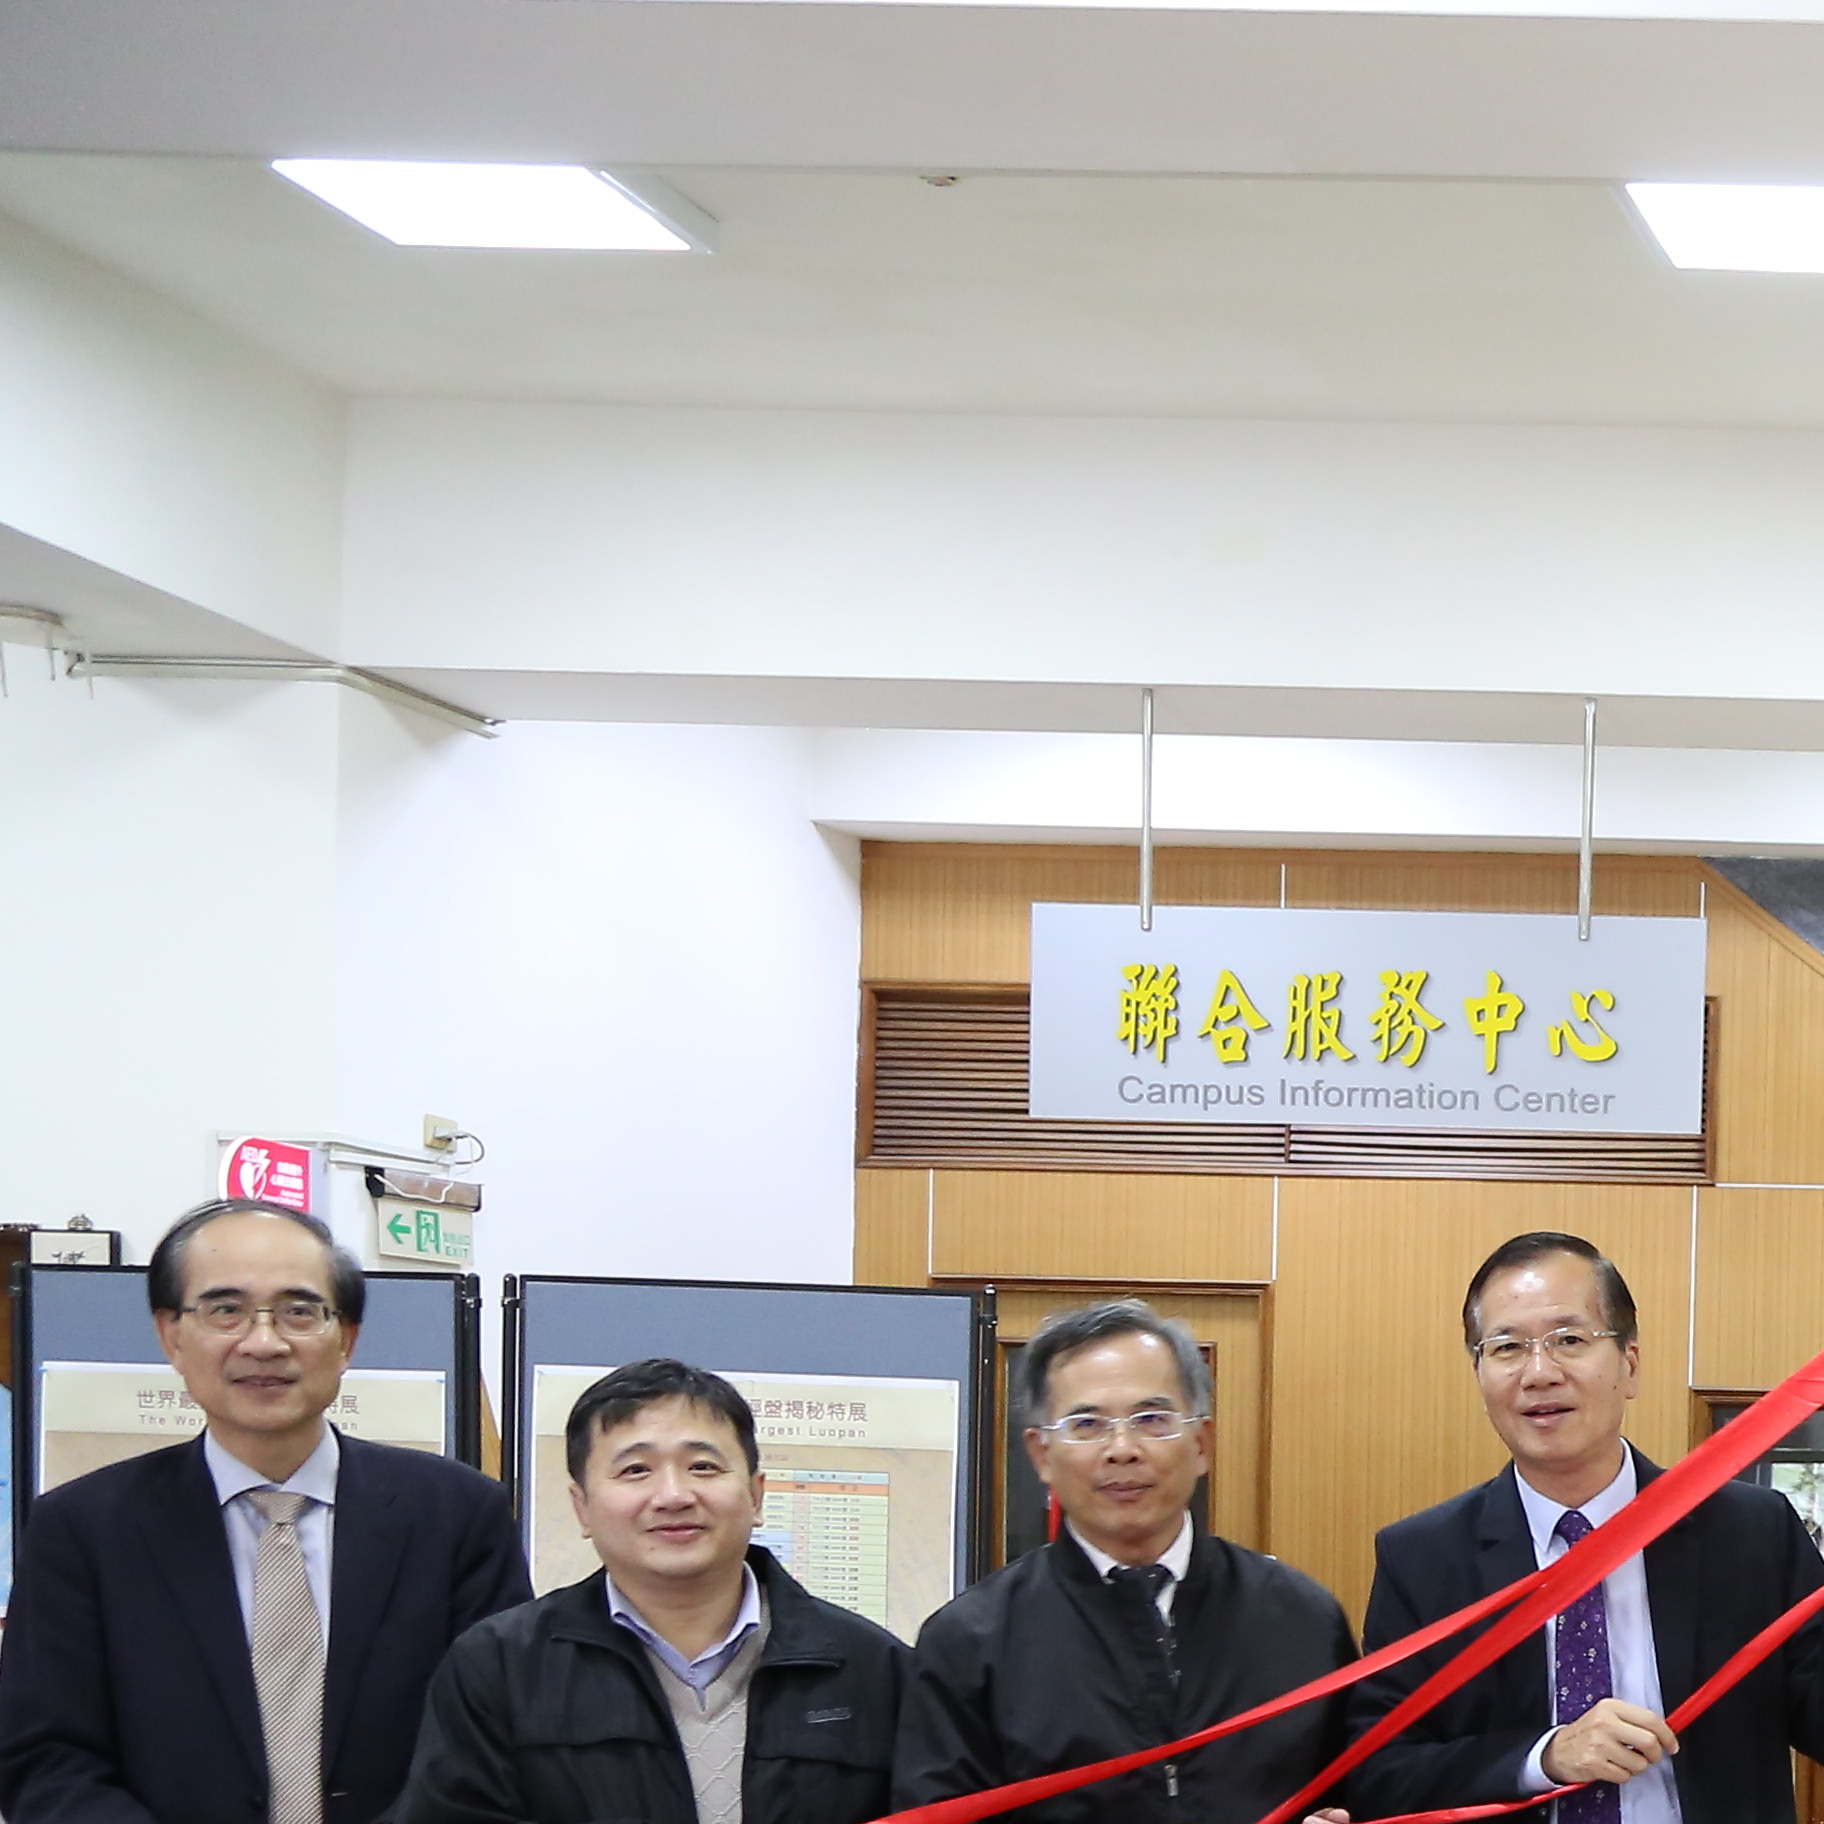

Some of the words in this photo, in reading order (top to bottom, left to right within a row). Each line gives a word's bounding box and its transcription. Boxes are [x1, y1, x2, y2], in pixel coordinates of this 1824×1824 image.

[1116, 963, 1618, 1074] 聯合服務中心
[1117, 1075, 1265, 1113] Campus
[1279, 1077, 1480, 1112] Information
[1493, 1082, 1616, 1115] Center
[139, 1414, 166, 1425] The
[175, 1415, 204, 1426] Wor
[808, 1426, 866, 1439] Luopan
